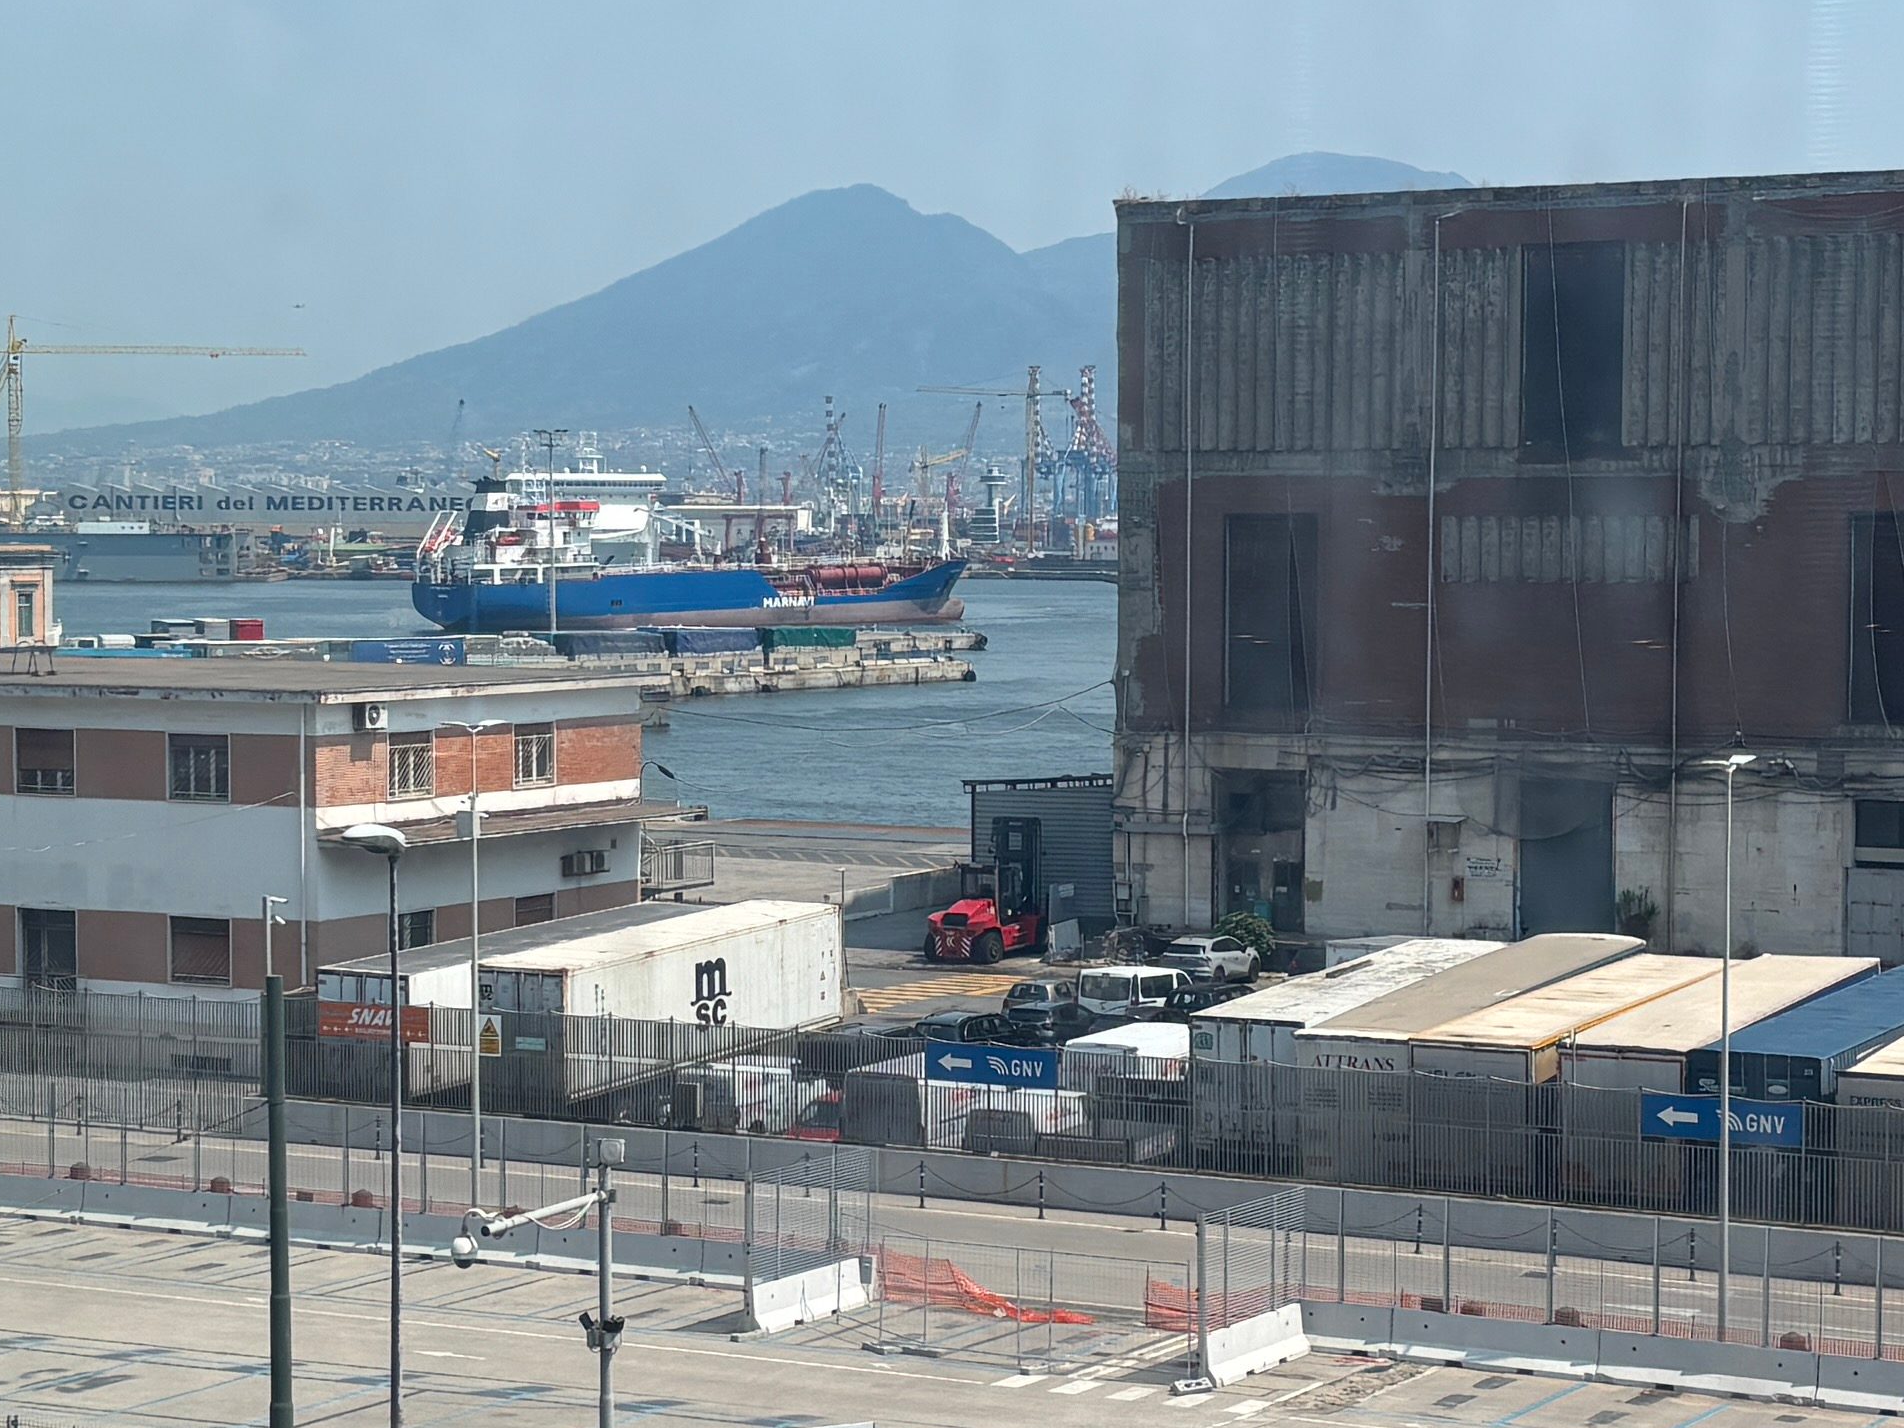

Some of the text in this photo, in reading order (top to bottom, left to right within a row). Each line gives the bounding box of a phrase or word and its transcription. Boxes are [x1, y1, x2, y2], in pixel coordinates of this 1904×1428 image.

[68, 494, 203, 511] CANTIERI
[216, 494, 254, 511] del
[763, 596, 815, 609] MARNAVI
[1011, 1059, 1043, 1077] GNV
[1746, 1113, 1785, 1134] GNV
